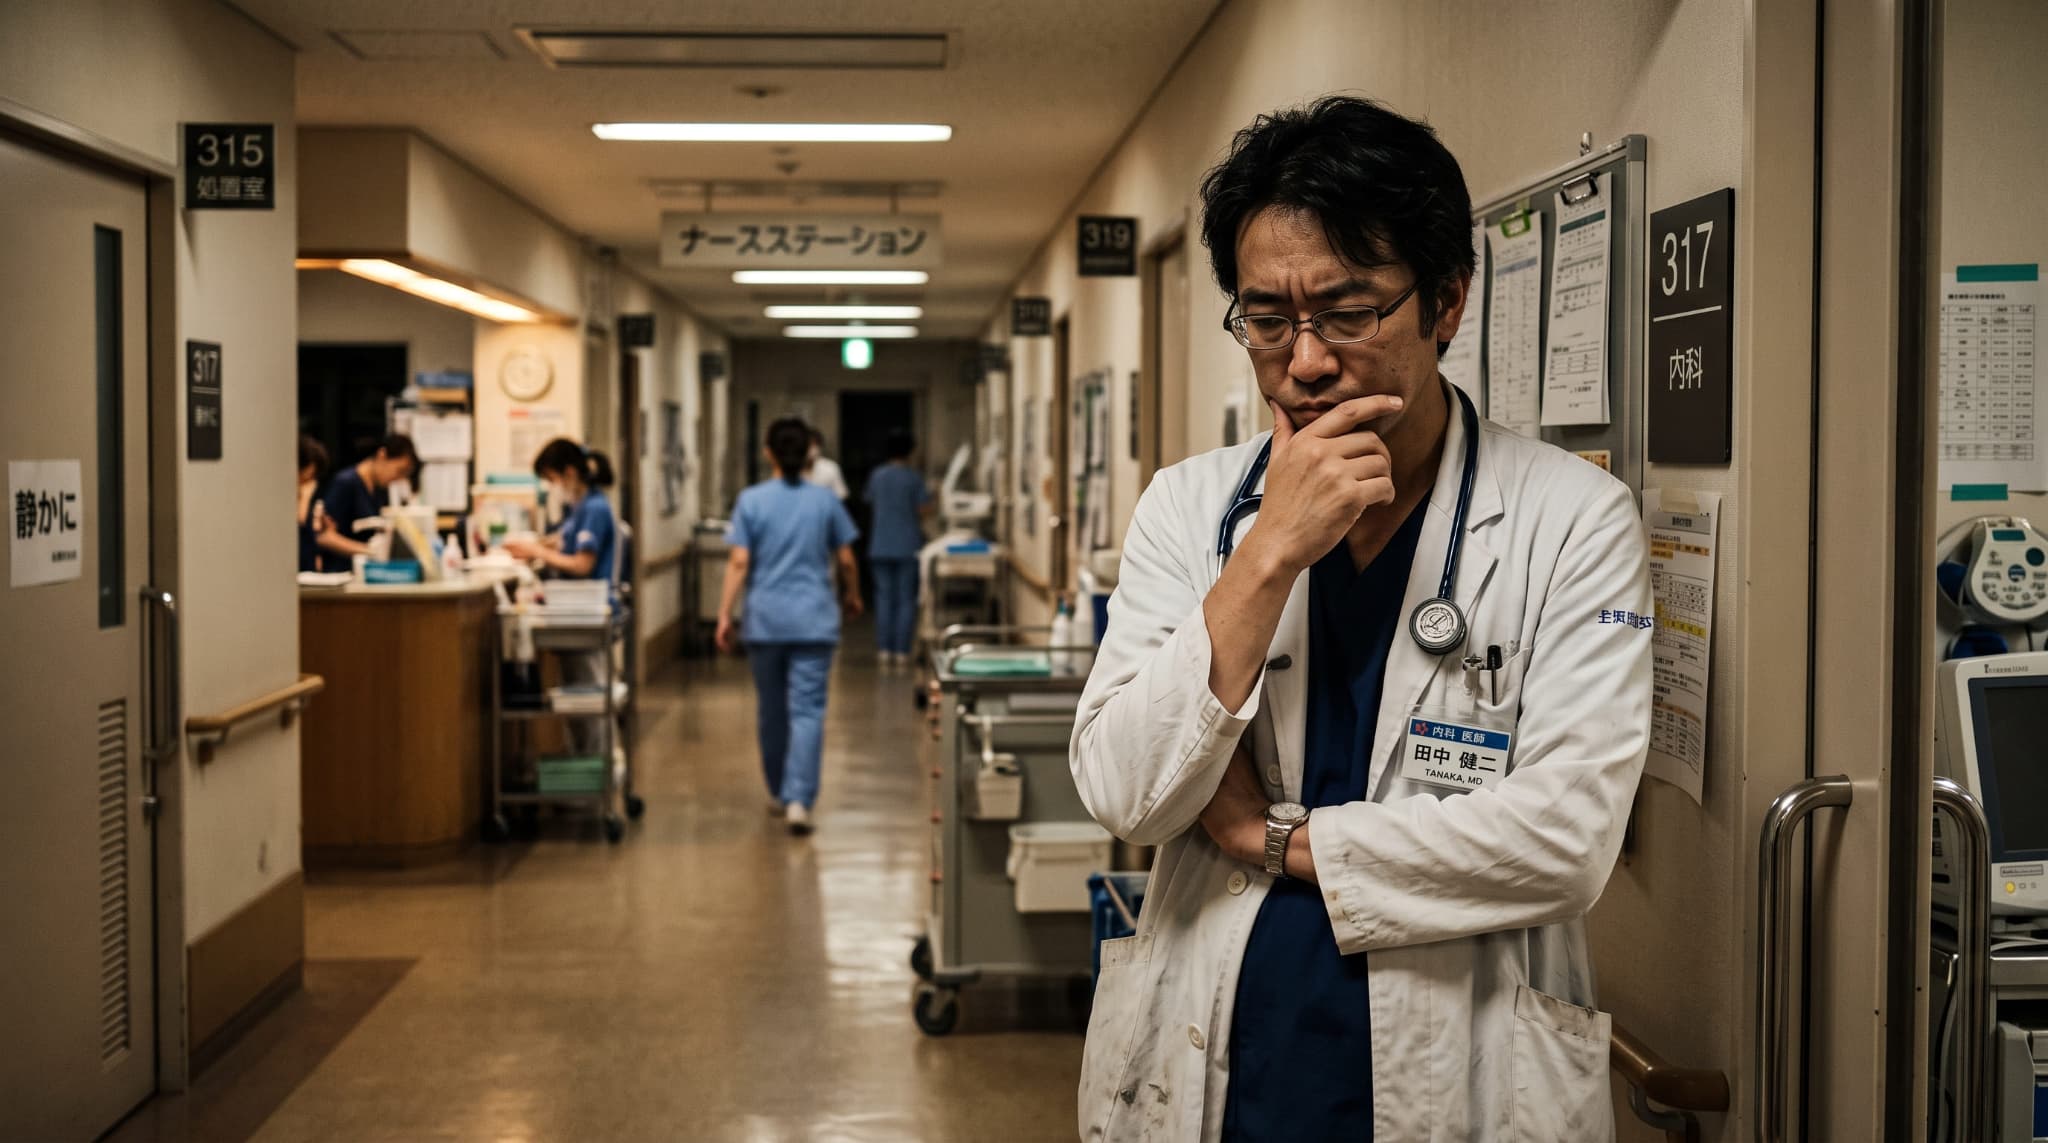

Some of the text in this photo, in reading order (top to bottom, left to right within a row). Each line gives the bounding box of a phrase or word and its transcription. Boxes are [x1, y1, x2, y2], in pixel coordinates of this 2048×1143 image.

[197, 133, 263, 167] 315
[679, 223, 927, 256] ナースステーション
[1083, 223, 1130, 249] 319
[1662, 220, 1714, 296] 317
[193, 350, 218, 382] 317
[1669, 346, 1703, 391] 内科
[15, 489, 77, 539] 静かに
[1432, 726, 1486, 744] 内科 医師
[1414, 744, 1497, 772] 田中 健二
[1425, 768, 1483, 785] TANAKA, MD
